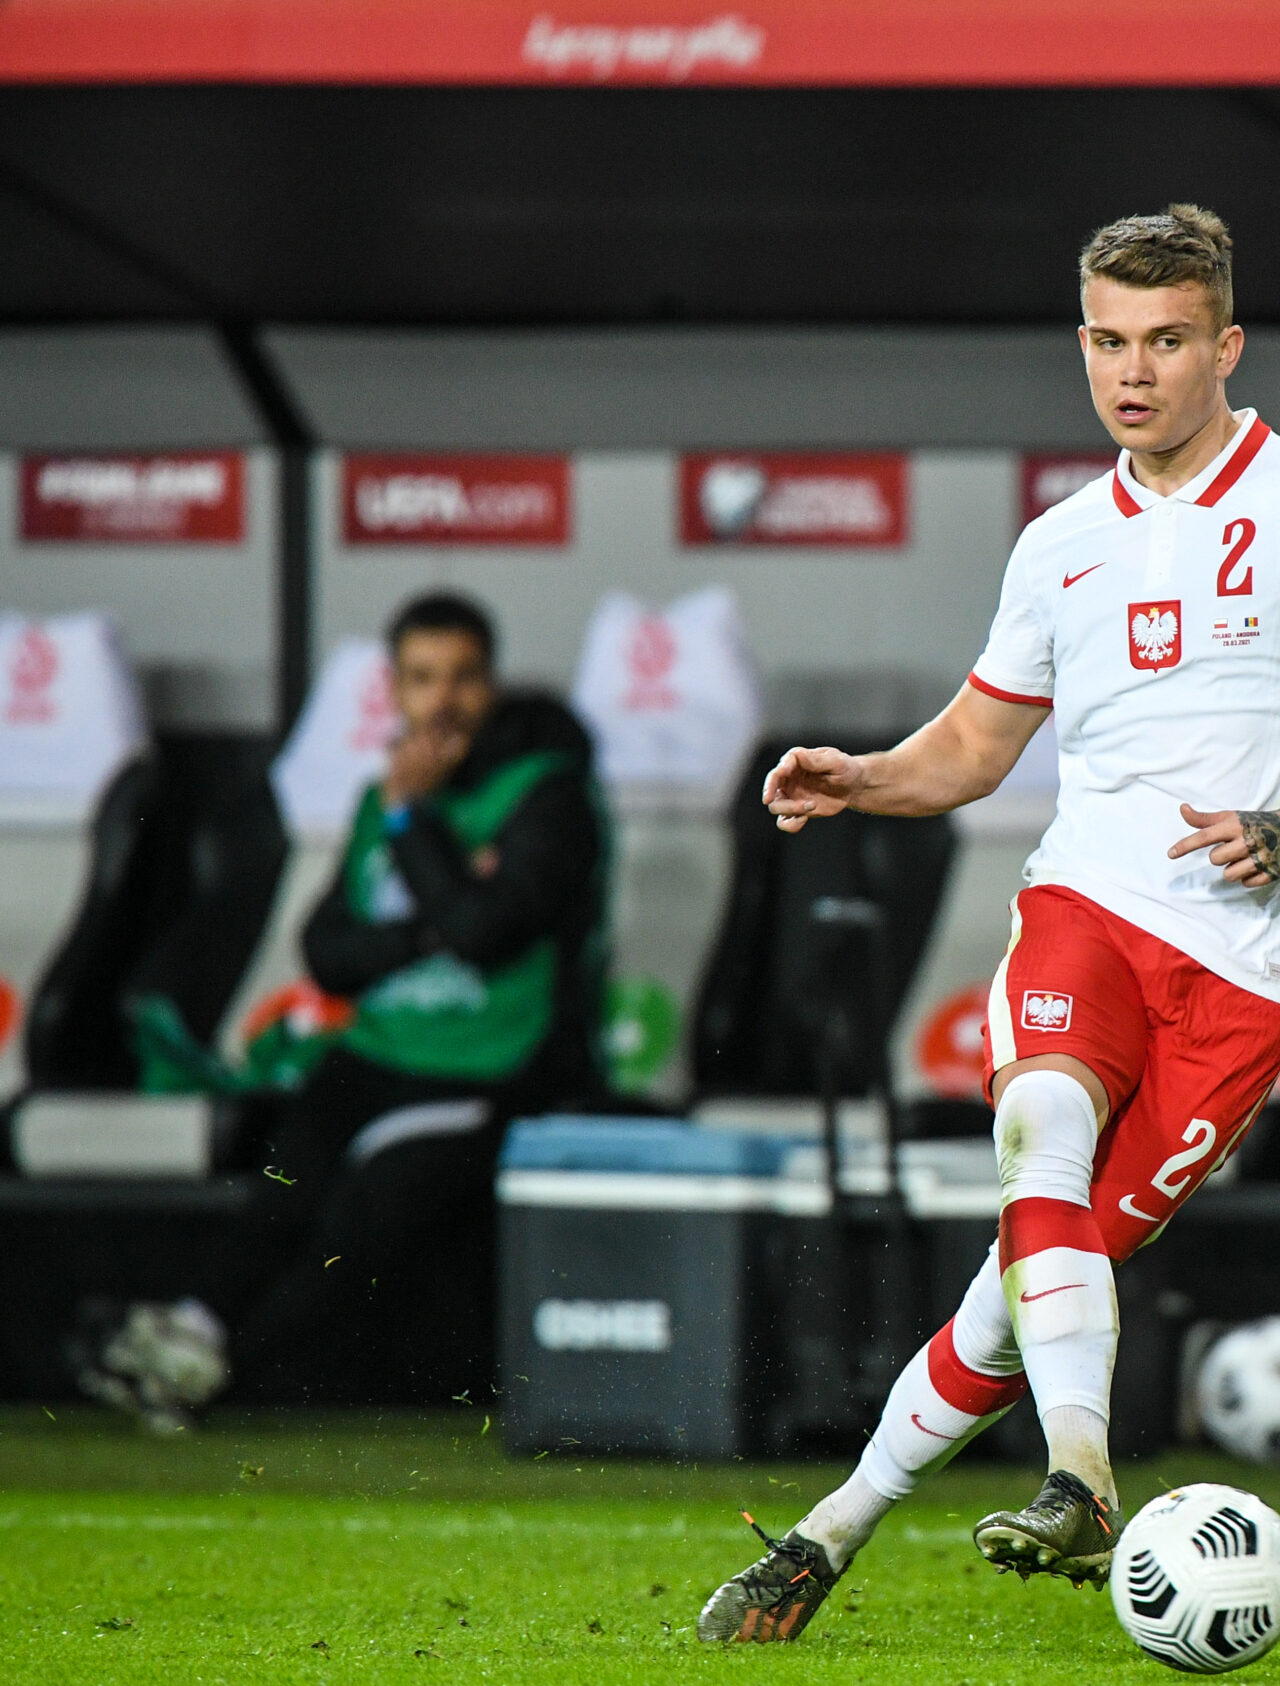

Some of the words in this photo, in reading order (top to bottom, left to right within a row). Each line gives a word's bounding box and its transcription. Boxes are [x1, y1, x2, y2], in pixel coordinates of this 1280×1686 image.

[1217, 517, 1256, 597] 2
[1211, 632, 1232, 640] POLAND
[1150, 1117, 1217, 1200] 2
